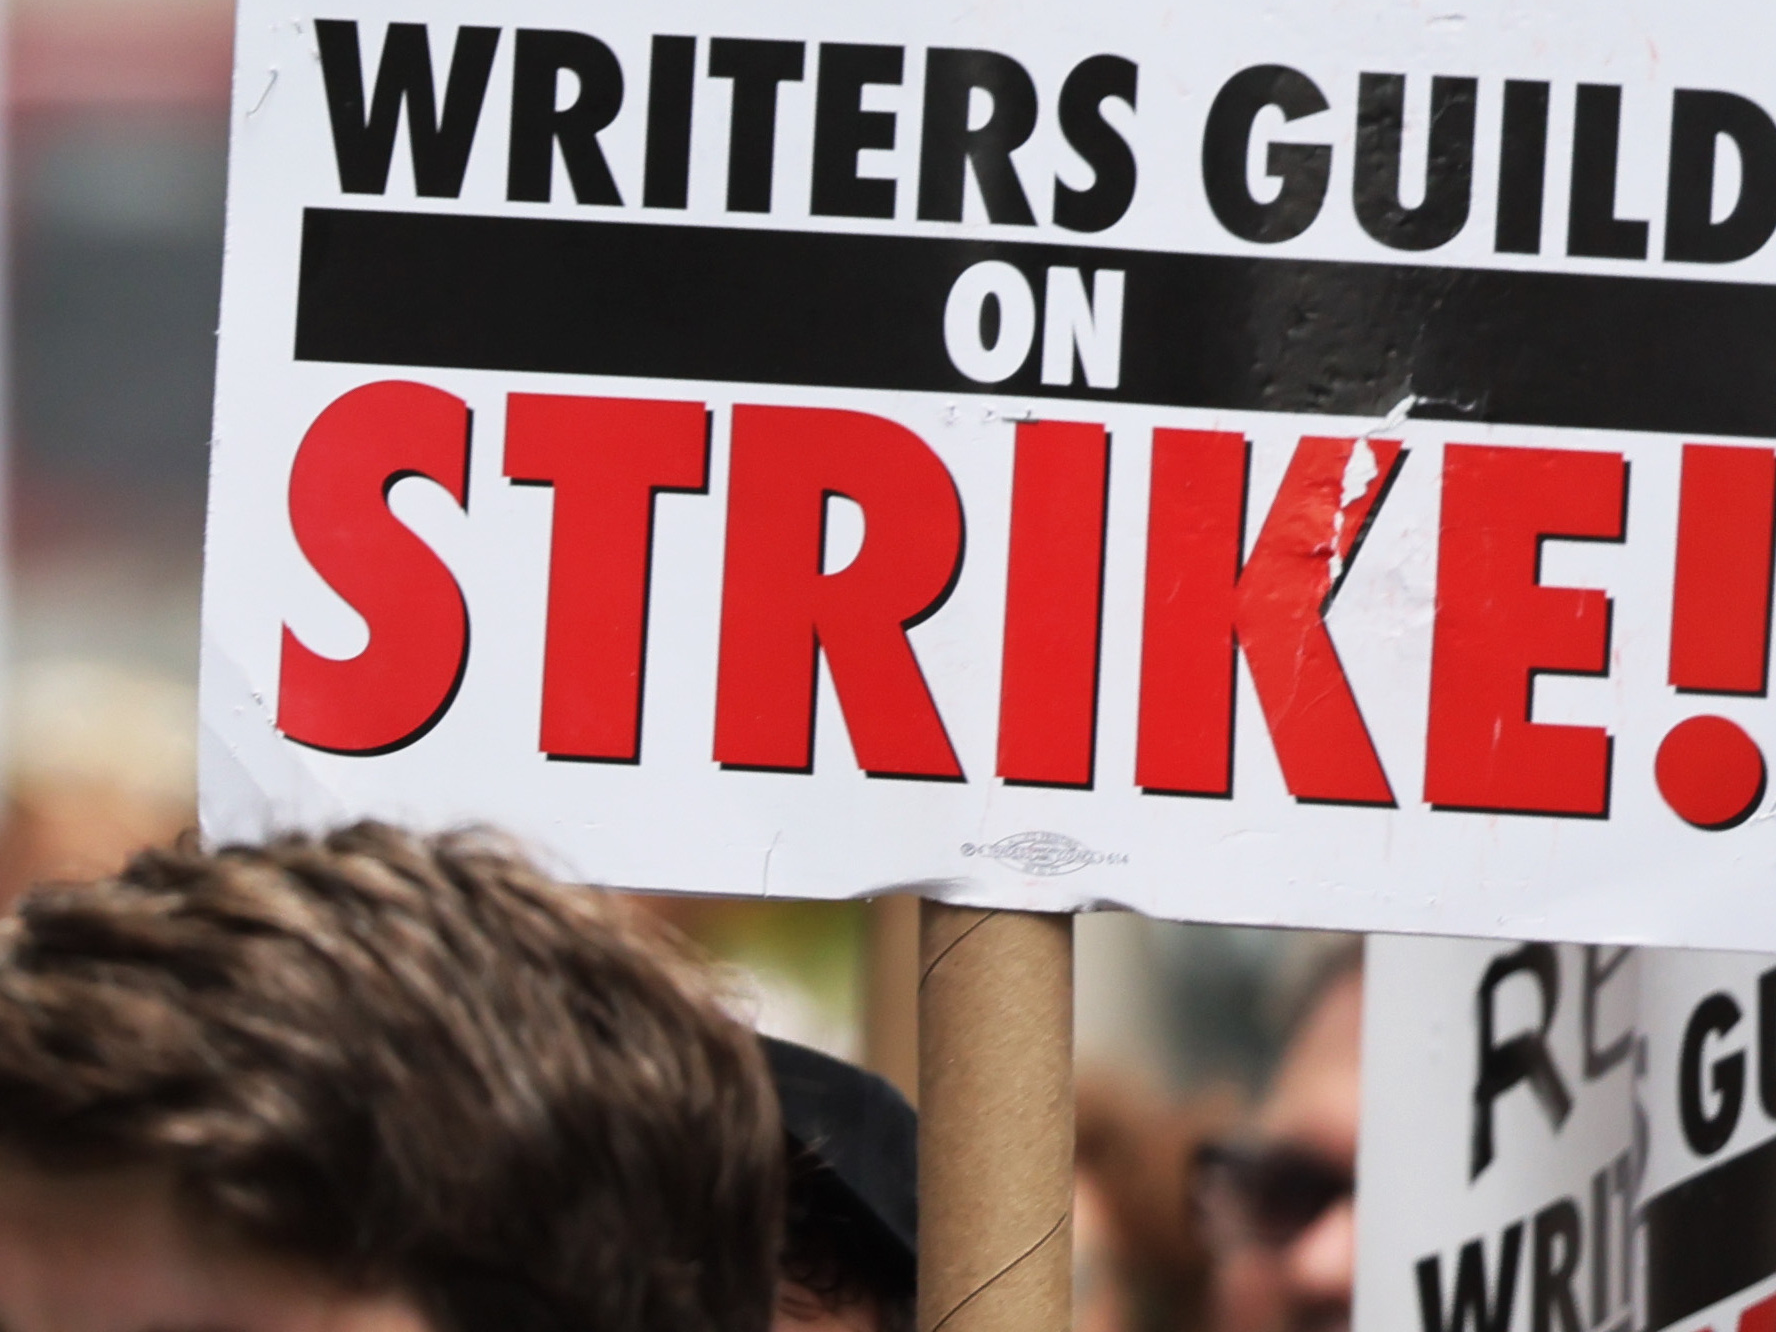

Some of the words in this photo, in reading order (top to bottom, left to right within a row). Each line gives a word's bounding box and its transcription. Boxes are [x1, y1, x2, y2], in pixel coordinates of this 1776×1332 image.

[315, 18, 1140, 234] WRITERS
[1200, 62, 1776, 265] GUILD
[944, 260, 1126, 390] ON
[274, 379, 1776, 832] STRIKE!
